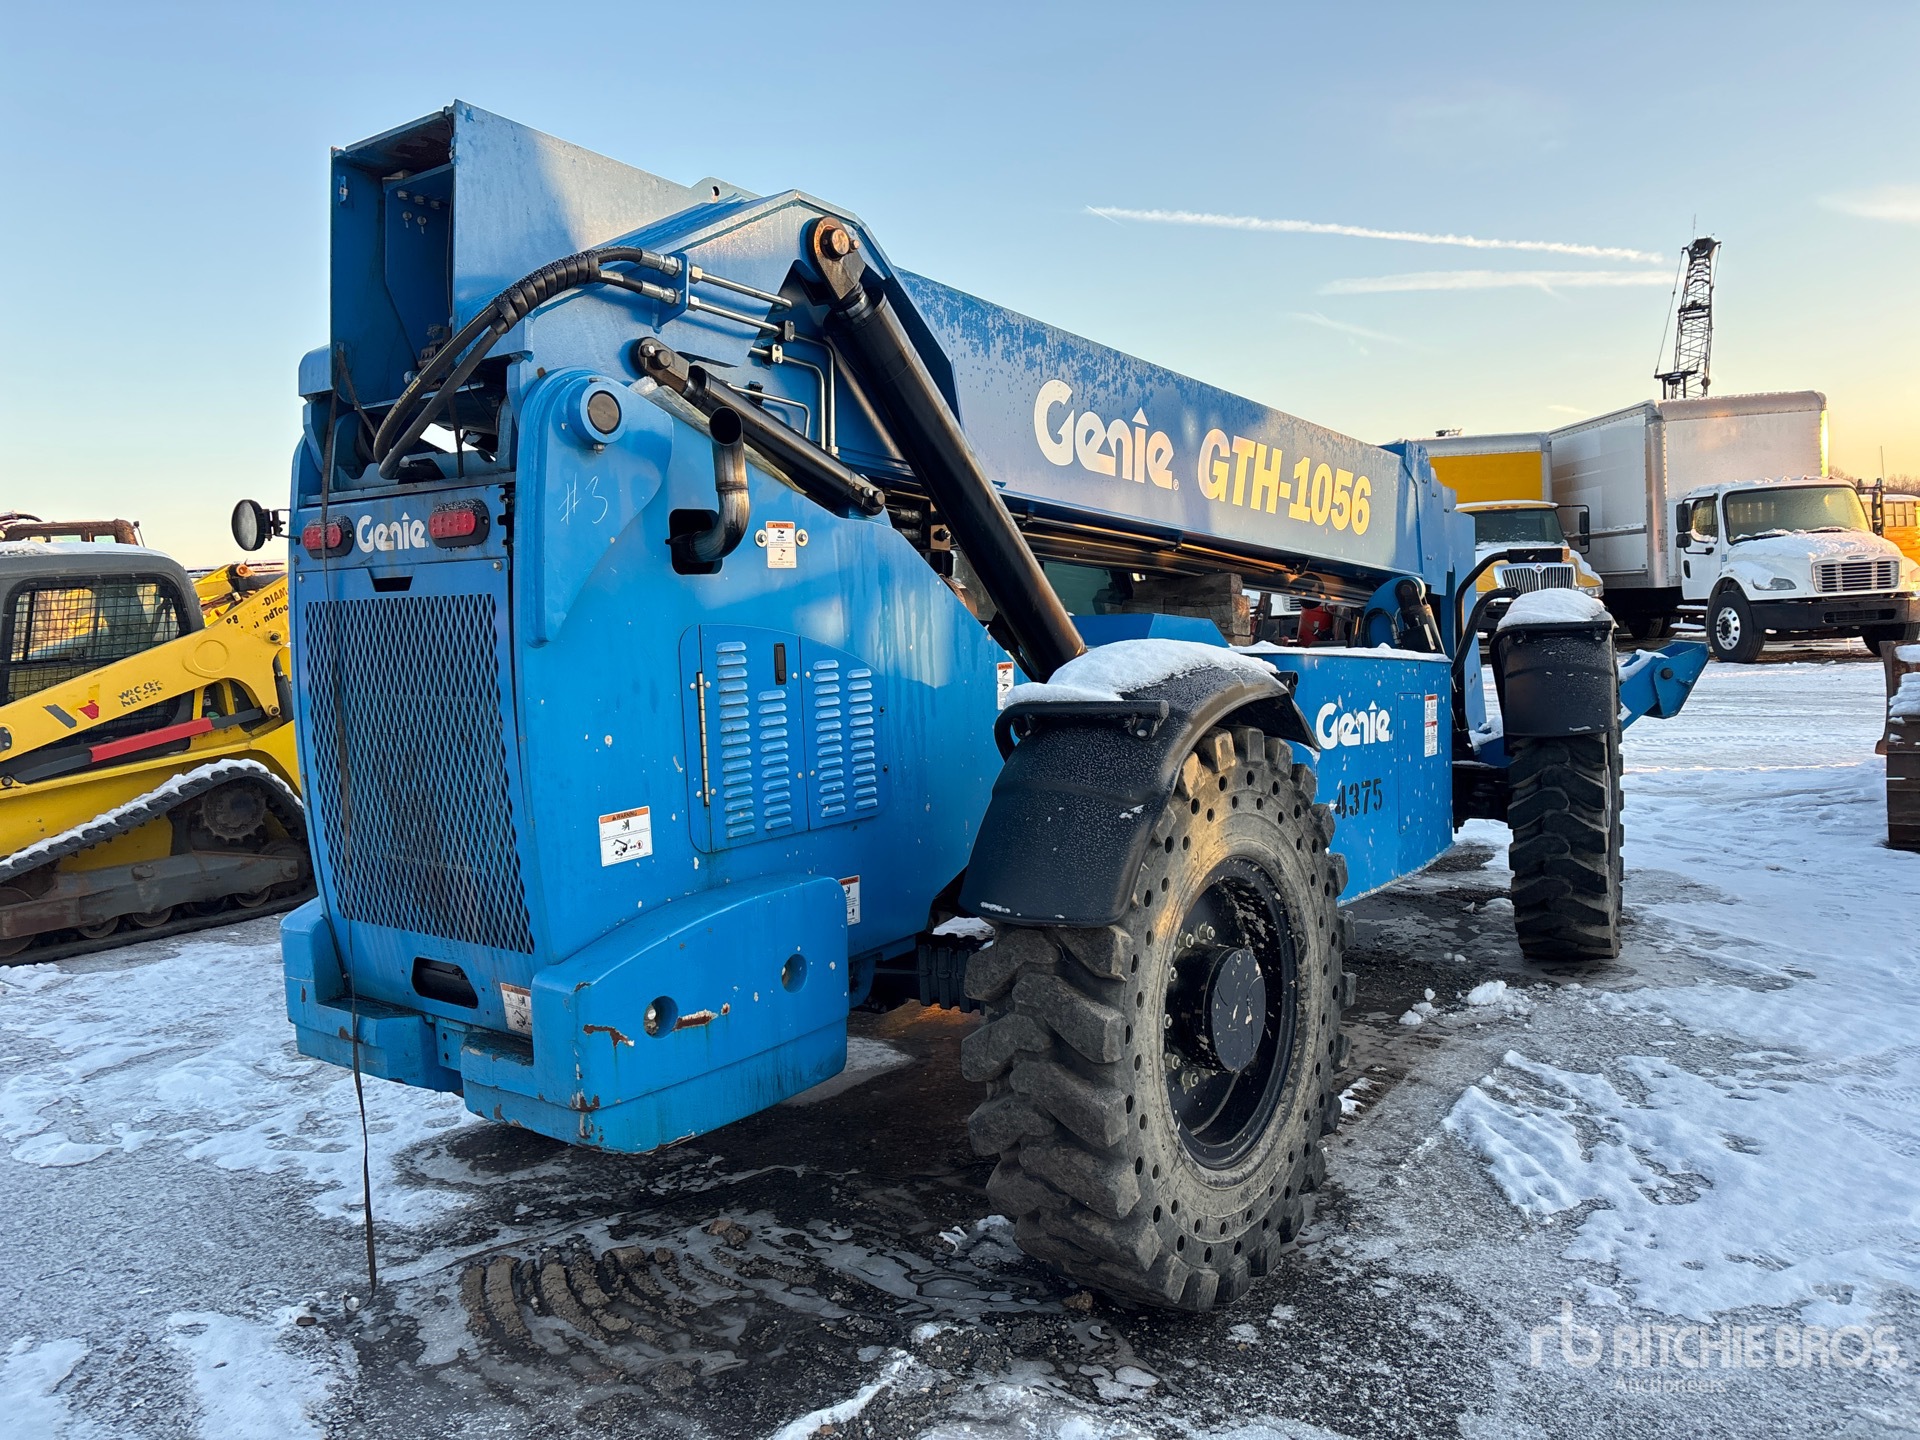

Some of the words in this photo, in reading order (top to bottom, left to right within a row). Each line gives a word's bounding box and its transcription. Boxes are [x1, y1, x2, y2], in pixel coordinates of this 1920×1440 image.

[1034, 379, 1174, 490] Genie
[1198, 428, 1372, 536] GTH-1056
[356, 511, 427, 553] Genie
[1316, 702, 1391, 750] Genie
[1334, 777, 1383, 819] 4375
